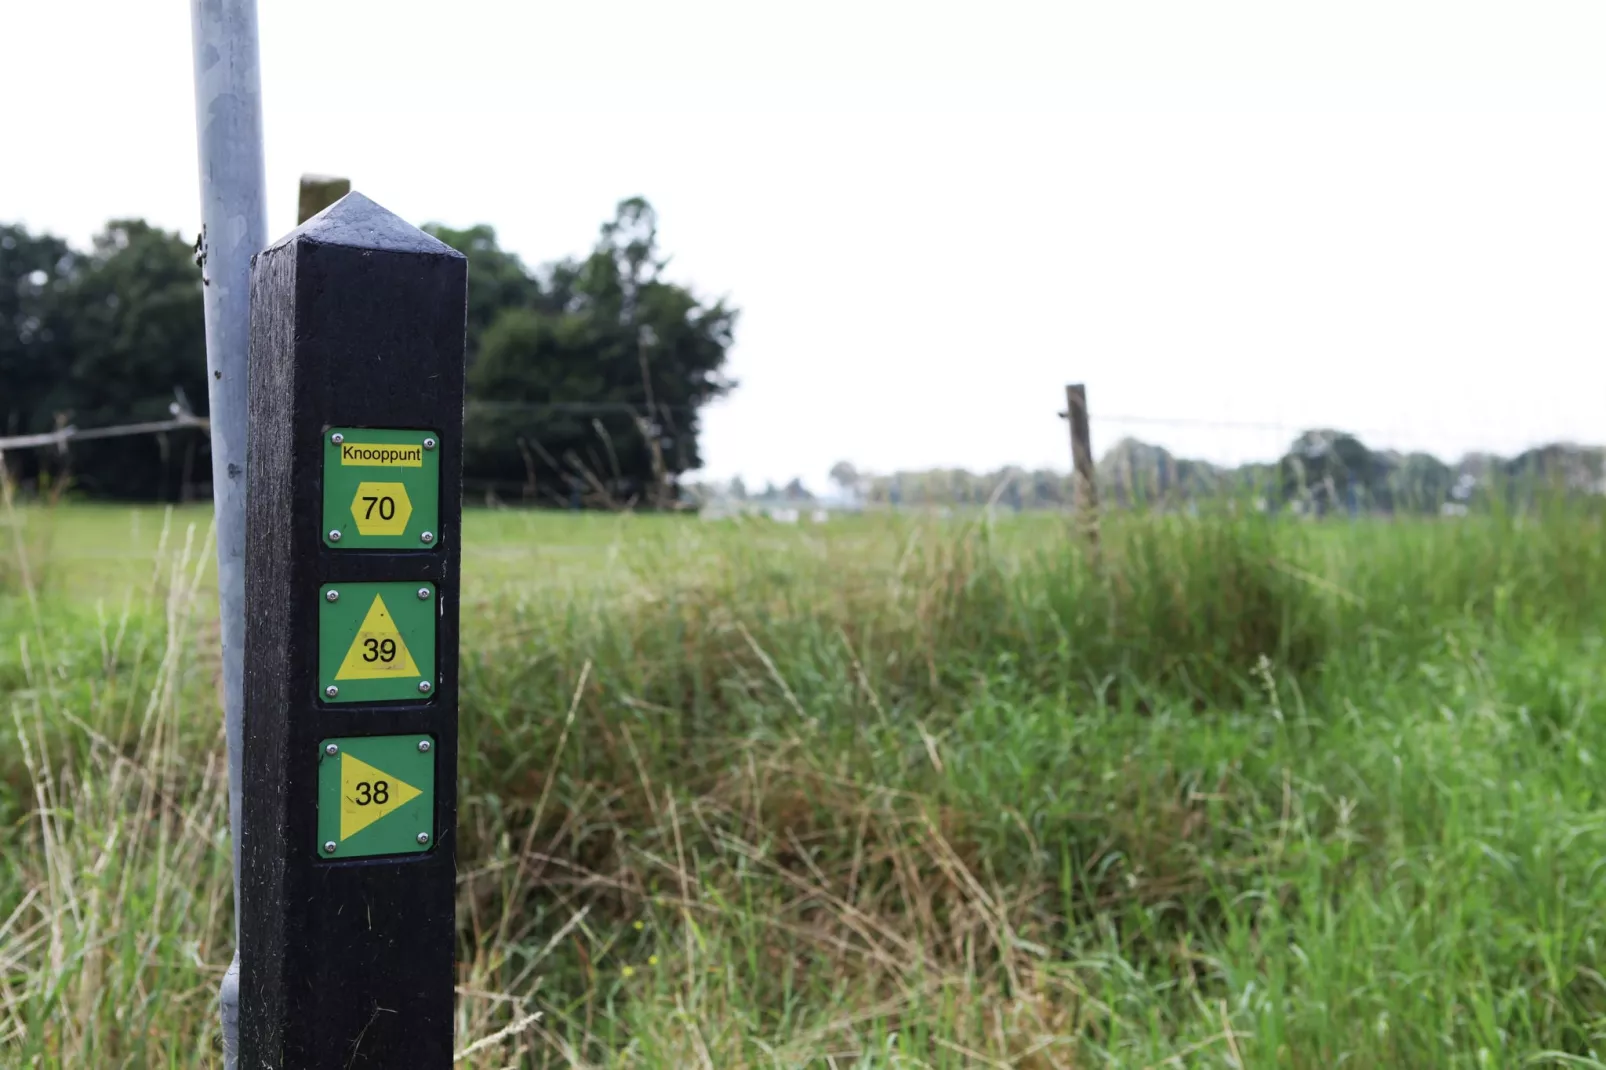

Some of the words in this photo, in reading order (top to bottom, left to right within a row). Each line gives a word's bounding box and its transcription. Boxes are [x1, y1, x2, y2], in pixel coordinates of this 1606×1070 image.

[343, 446, 421, 463] Knooppunt
[362, 496, 395, 520] 70
[362, 638, 396, 662] 39
[355, 780, 389, 806] 38
